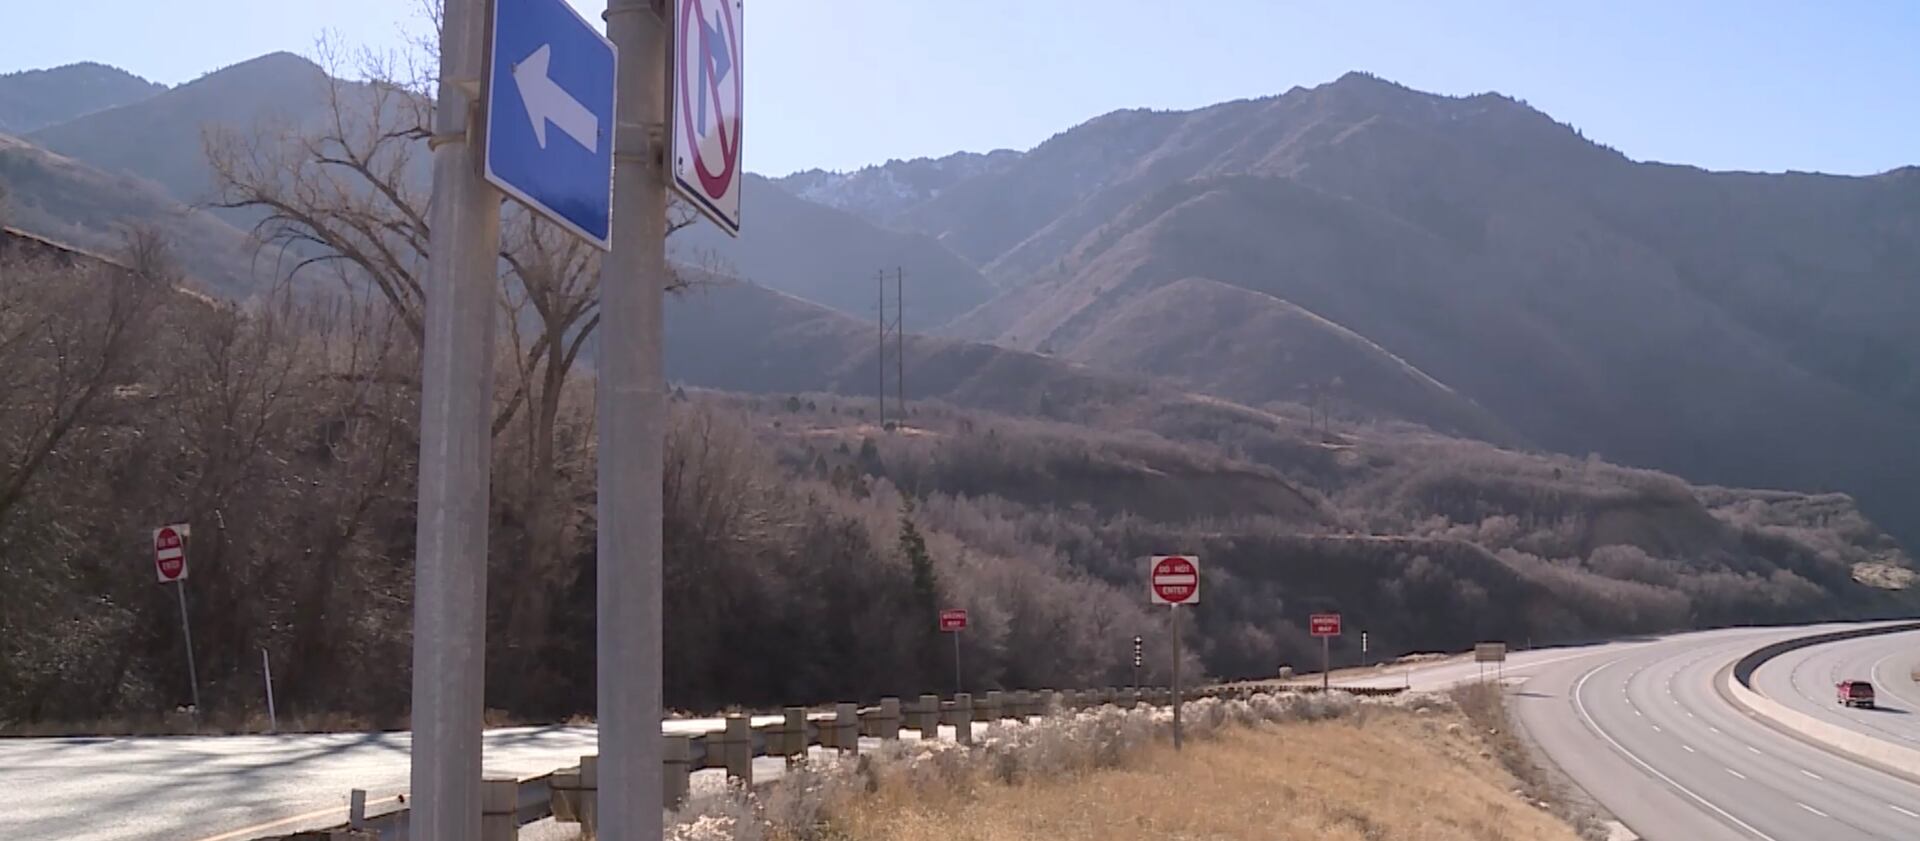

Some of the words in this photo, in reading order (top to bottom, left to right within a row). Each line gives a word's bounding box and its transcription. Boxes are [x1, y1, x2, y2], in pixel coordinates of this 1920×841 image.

[1158, 565, 1170, 573] DO
[1174, 564, 1190, 573] NOT
[1162, 586, 1188, 595] ENTER
